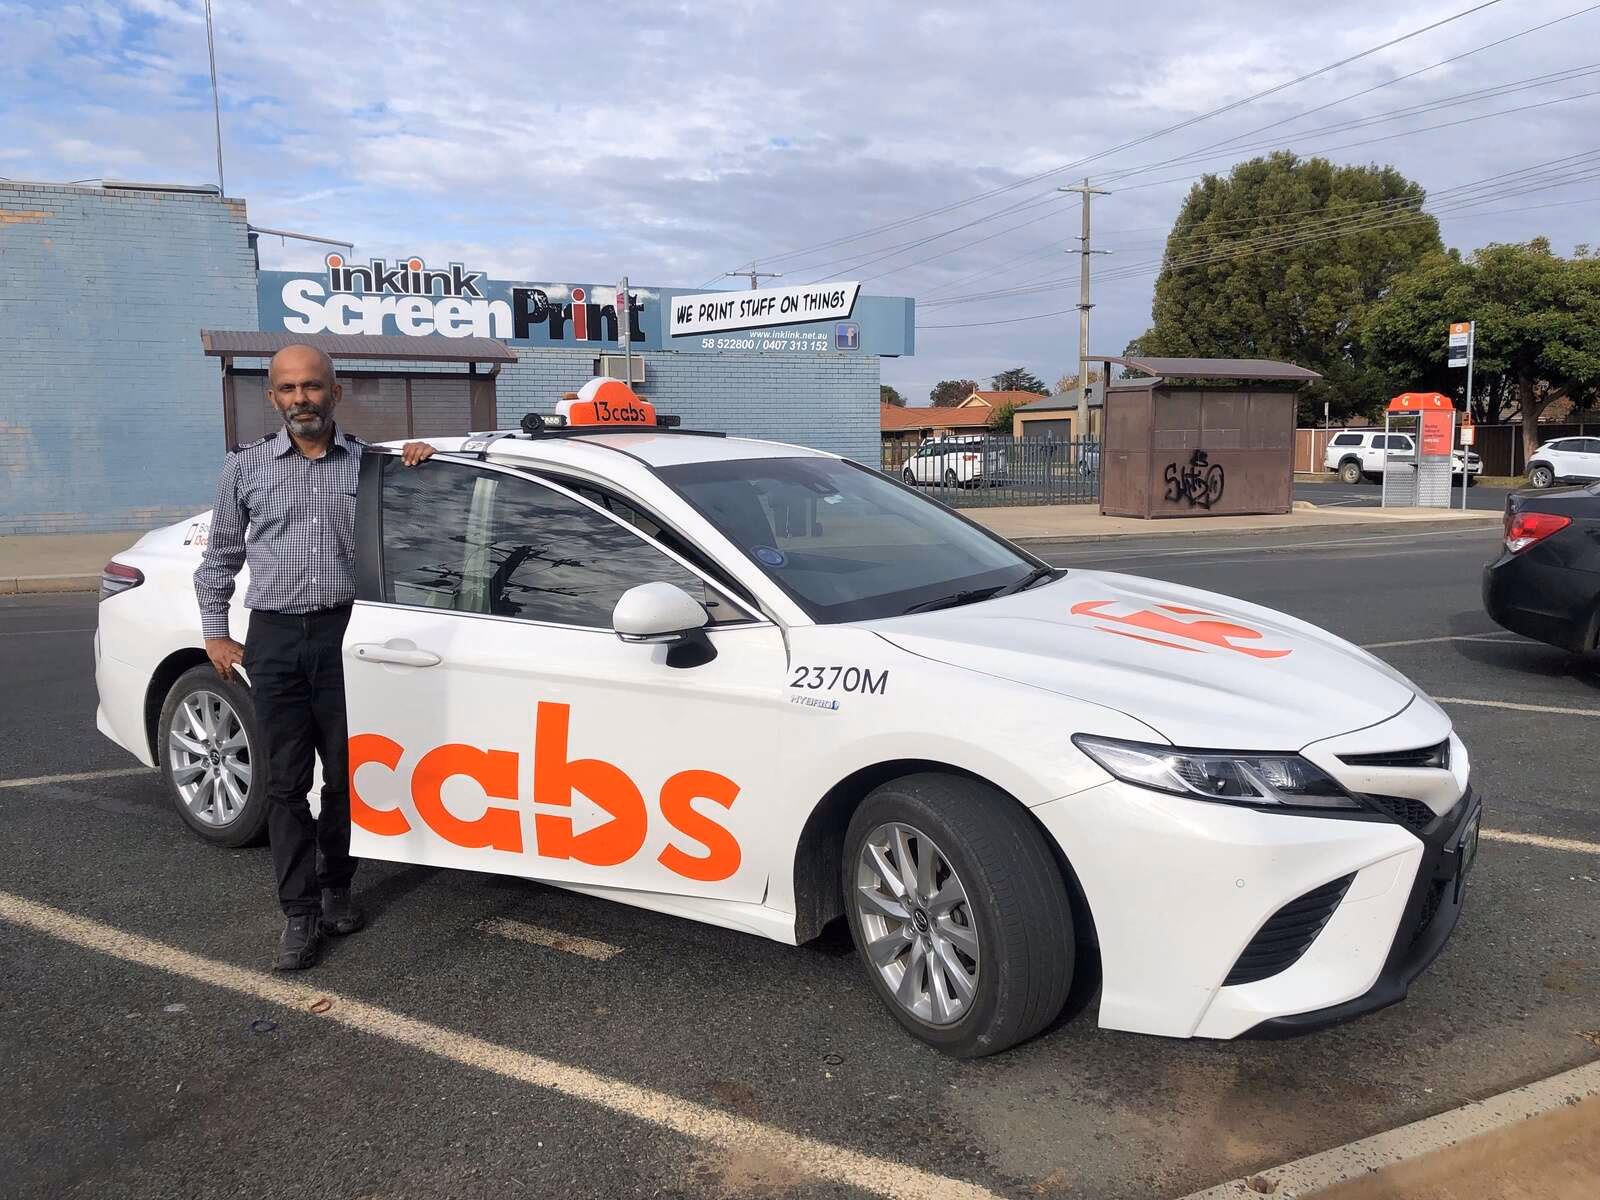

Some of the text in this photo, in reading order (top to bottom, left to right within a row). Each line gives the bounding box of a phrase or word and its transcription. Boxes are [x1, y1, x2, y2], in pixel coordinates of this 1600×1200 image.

[327, 254, 484, 297] inklink
[282, 278, 513, 338] Screen
[512, 287, 646, 342] Print
[676, 290, 846, 325] WE PRINT STUFF ON THINGS
[701, 338, 715, 349] 58
[717, 338, 754, 350] 522800
[763, 340, 787, 350] 0407
[789, 340, 808, 351] 313
[810, 341, 828, 351] 152
[749, 330, 828, 340] www.inklink.net.au
[593, 401, 646, 422] 13cabs
[789, 666, 889, 695] 2370M
[348, 701, 742, 882] cabs
